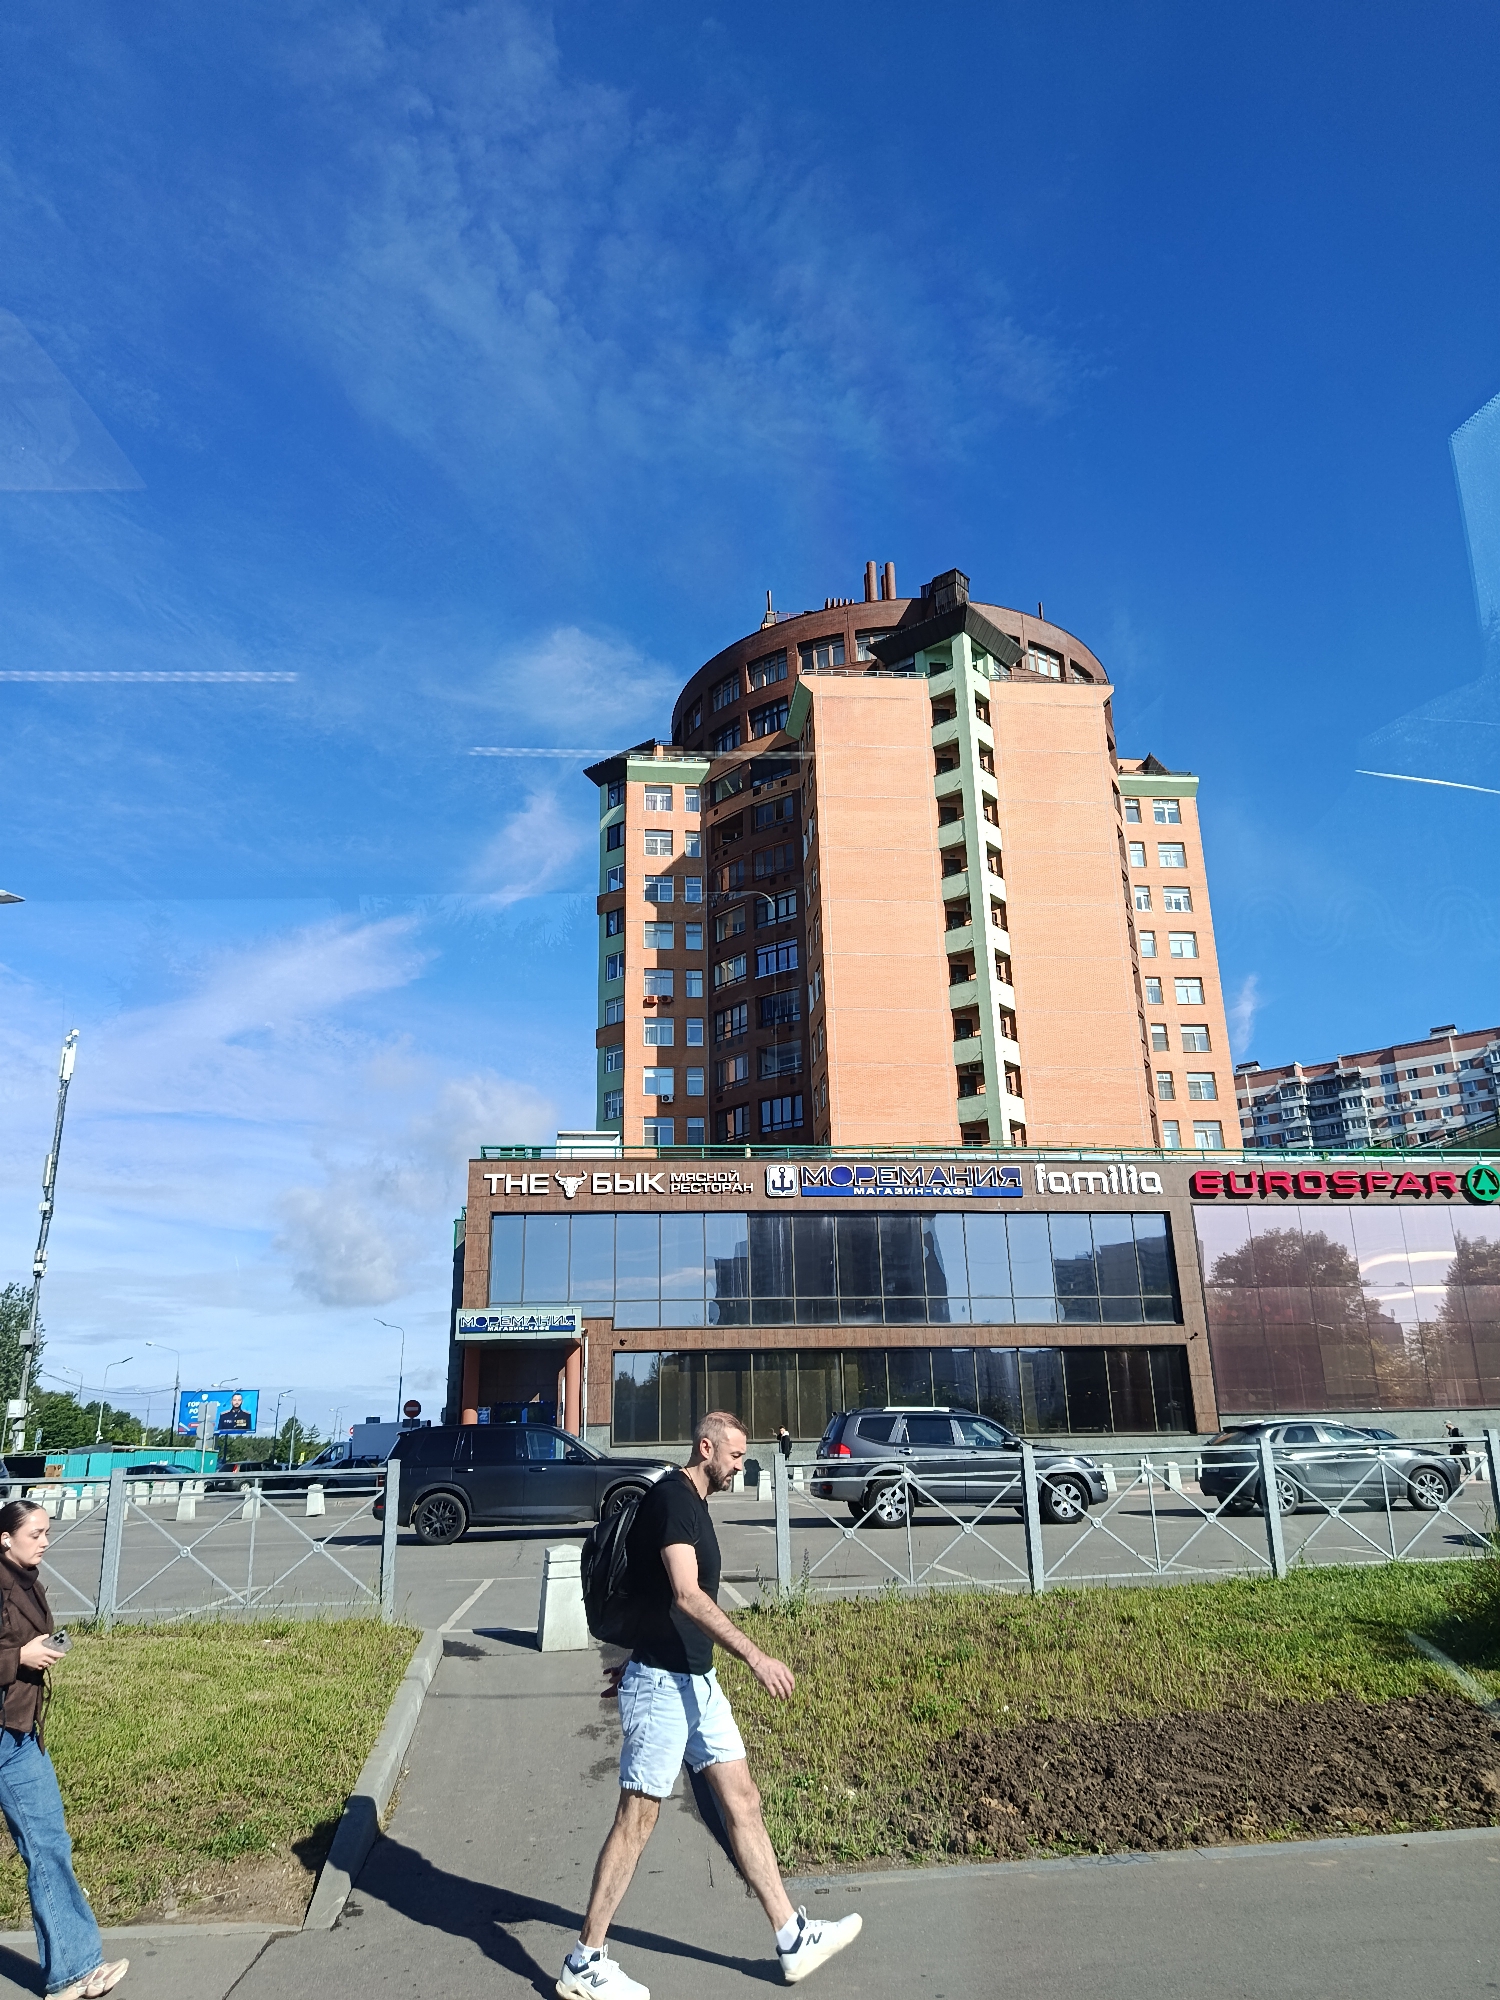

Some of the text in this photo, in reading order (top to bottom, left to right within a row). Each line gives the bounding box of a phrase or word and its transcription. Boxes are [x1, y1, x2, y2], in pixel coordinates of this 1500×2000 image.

[484, 1172, 666, 1194] THE БЫК
[671, 1170, 740, 1182] МЯСНОЙ
[801, 1165, 1022, 1187] МОРЕМАНИЯ
[1035, 1163, 1163, 1194] familia
[1195, 1170, 1459, 1194] EUROSPAR
[671, 1182, 754, 1193] РЕСТОРАН
[853, 1187, 973, 1196] МАГАЗИН-КАФЕ
[461, 1314, 577, 1327] МОРЕМАНИЯ
